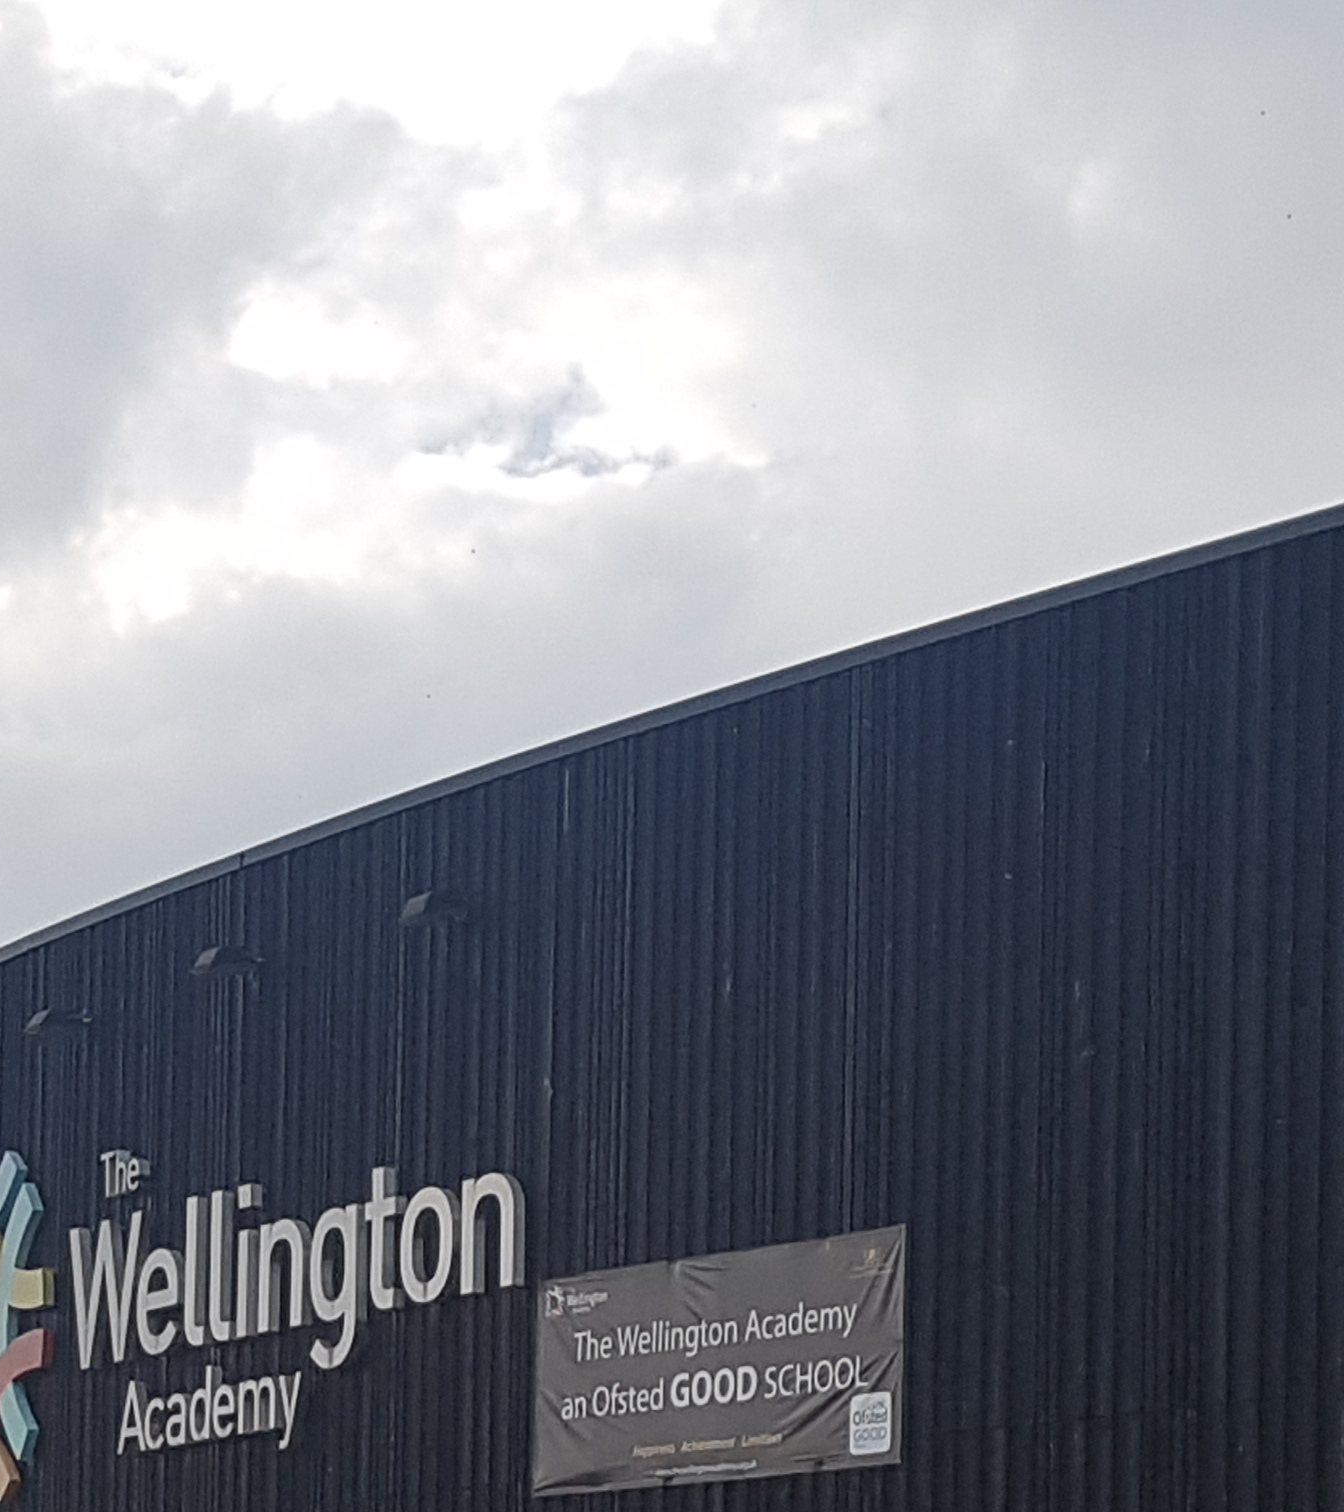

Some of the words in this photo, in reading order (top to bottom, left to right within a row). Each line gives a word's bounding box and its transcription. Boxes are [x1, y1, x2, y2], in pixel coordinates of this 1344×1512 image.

[100, 1150, 148, 1198] The
[69, 1166, 524, 1370] Wellington
[573, 1330, 613, 1362] The
[617, 1319, 739, 1358] Wellington
[744, 1302, 858, 1341] Academy
[117, 1365, 302, 1455] Academy
[560, 1394, 587, 1421] an
[591, 1378, 664, 1418] Ofsted
[669, 1365, 758, 1408] GOOD
[763, 1356, 869, 1400] SCHOOL
